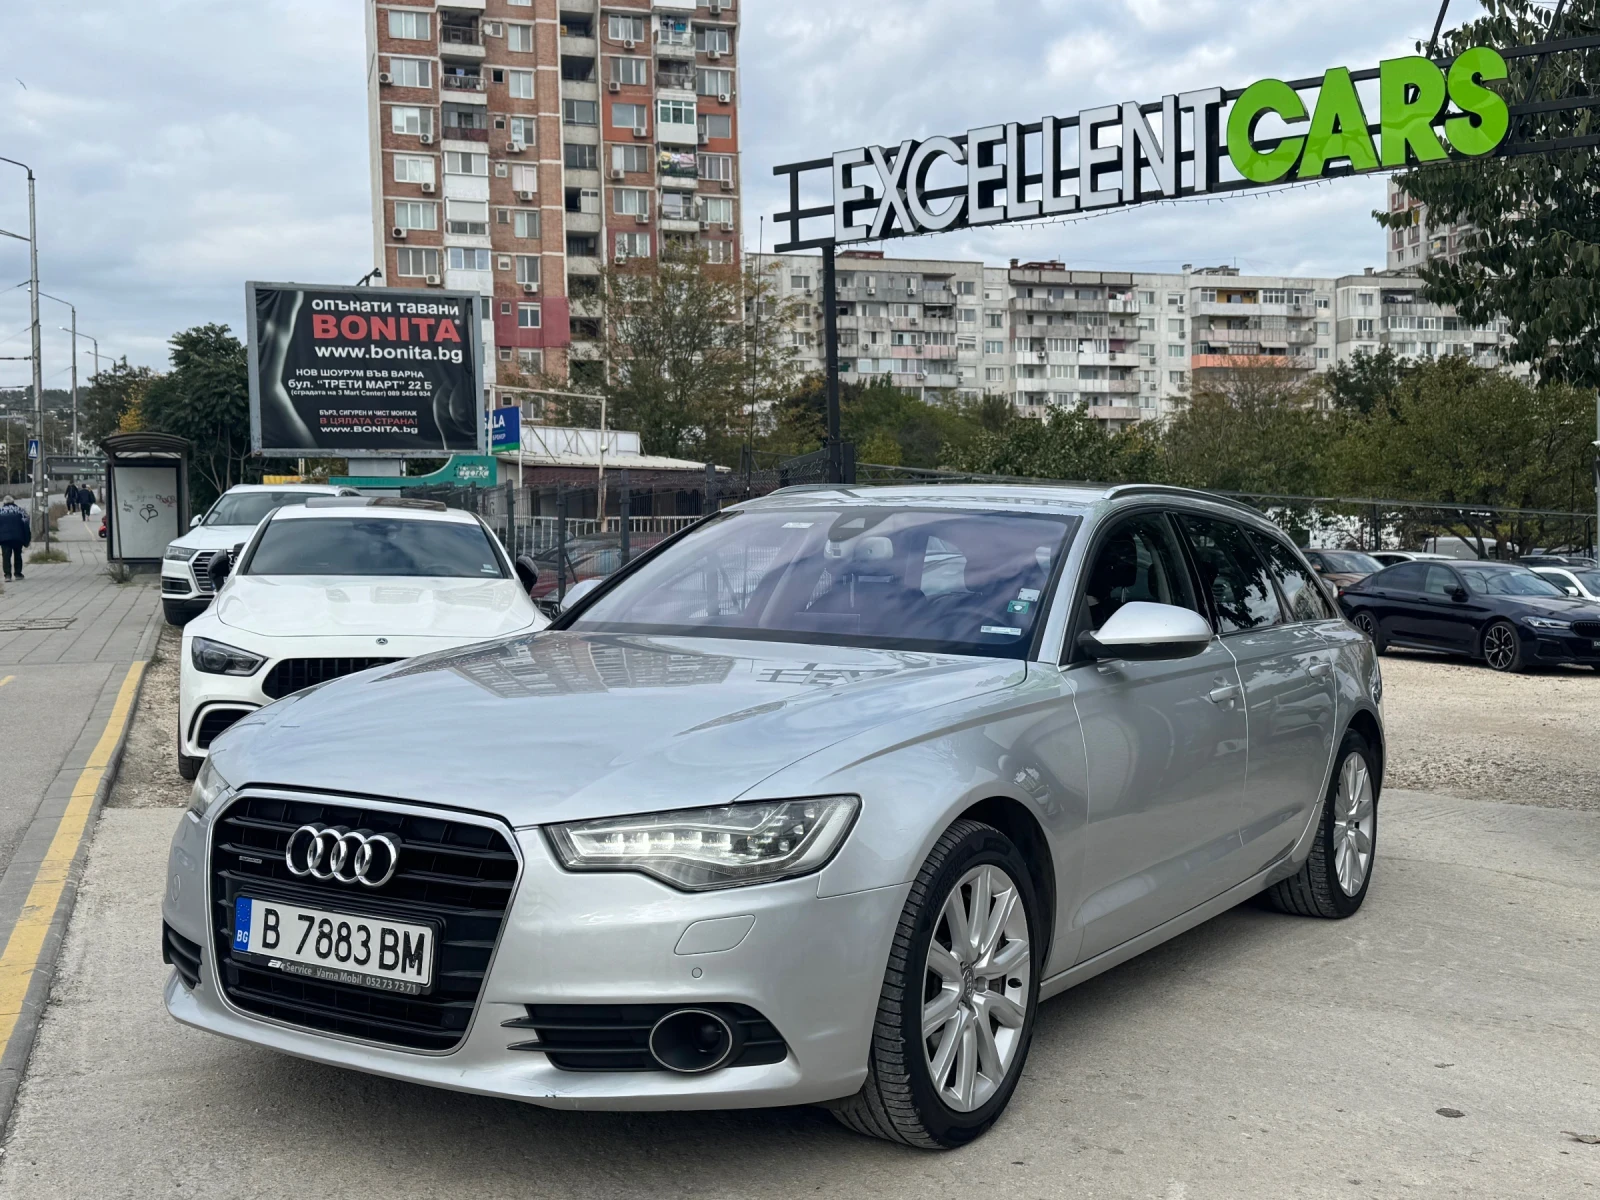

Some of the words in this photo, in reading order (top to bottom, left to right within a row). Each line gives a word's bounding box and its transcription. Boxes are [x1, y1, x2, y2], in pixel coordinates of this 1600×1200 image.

[833, 86, 1225, 243] EXCELLENT
[1227, 46, 1509, 184] CARS
[312, 299, 392, 313] опънати
[397, 301, 459, 316] тавани
[312, 313, 462, 343] BONITA
[314, 344, 463, 364] www.bonita.bg
[296, 369, 318, 377] НОВ
[320, 369, 364, 377] ШОУРУМ
[366, 370, 389, 378] ВЪВ
[391, 370, 424, 379] ВАРНА
[288, 379, 314, 390] бул.
[408, 381, 421, 390] 22
[424, 381, 433, 390] Б
[320, 417, 327, 425] В
[330, 417, 372, 425] ЦЯЛАТА
[374, 417, 418, 425] СТРАНА!
[320, 426, 418, 434] www.BONITA.bg
[236, 930, 248, 943] BG
[262, 908, 280, 950] B
[296, 913, 371, 966] 7883
[379, 927, 425, 976] BM
[286, 962, 312, 976] Service
[316, 968, 338, 981] Varna
[339, 972, 362, 985] Mobil
